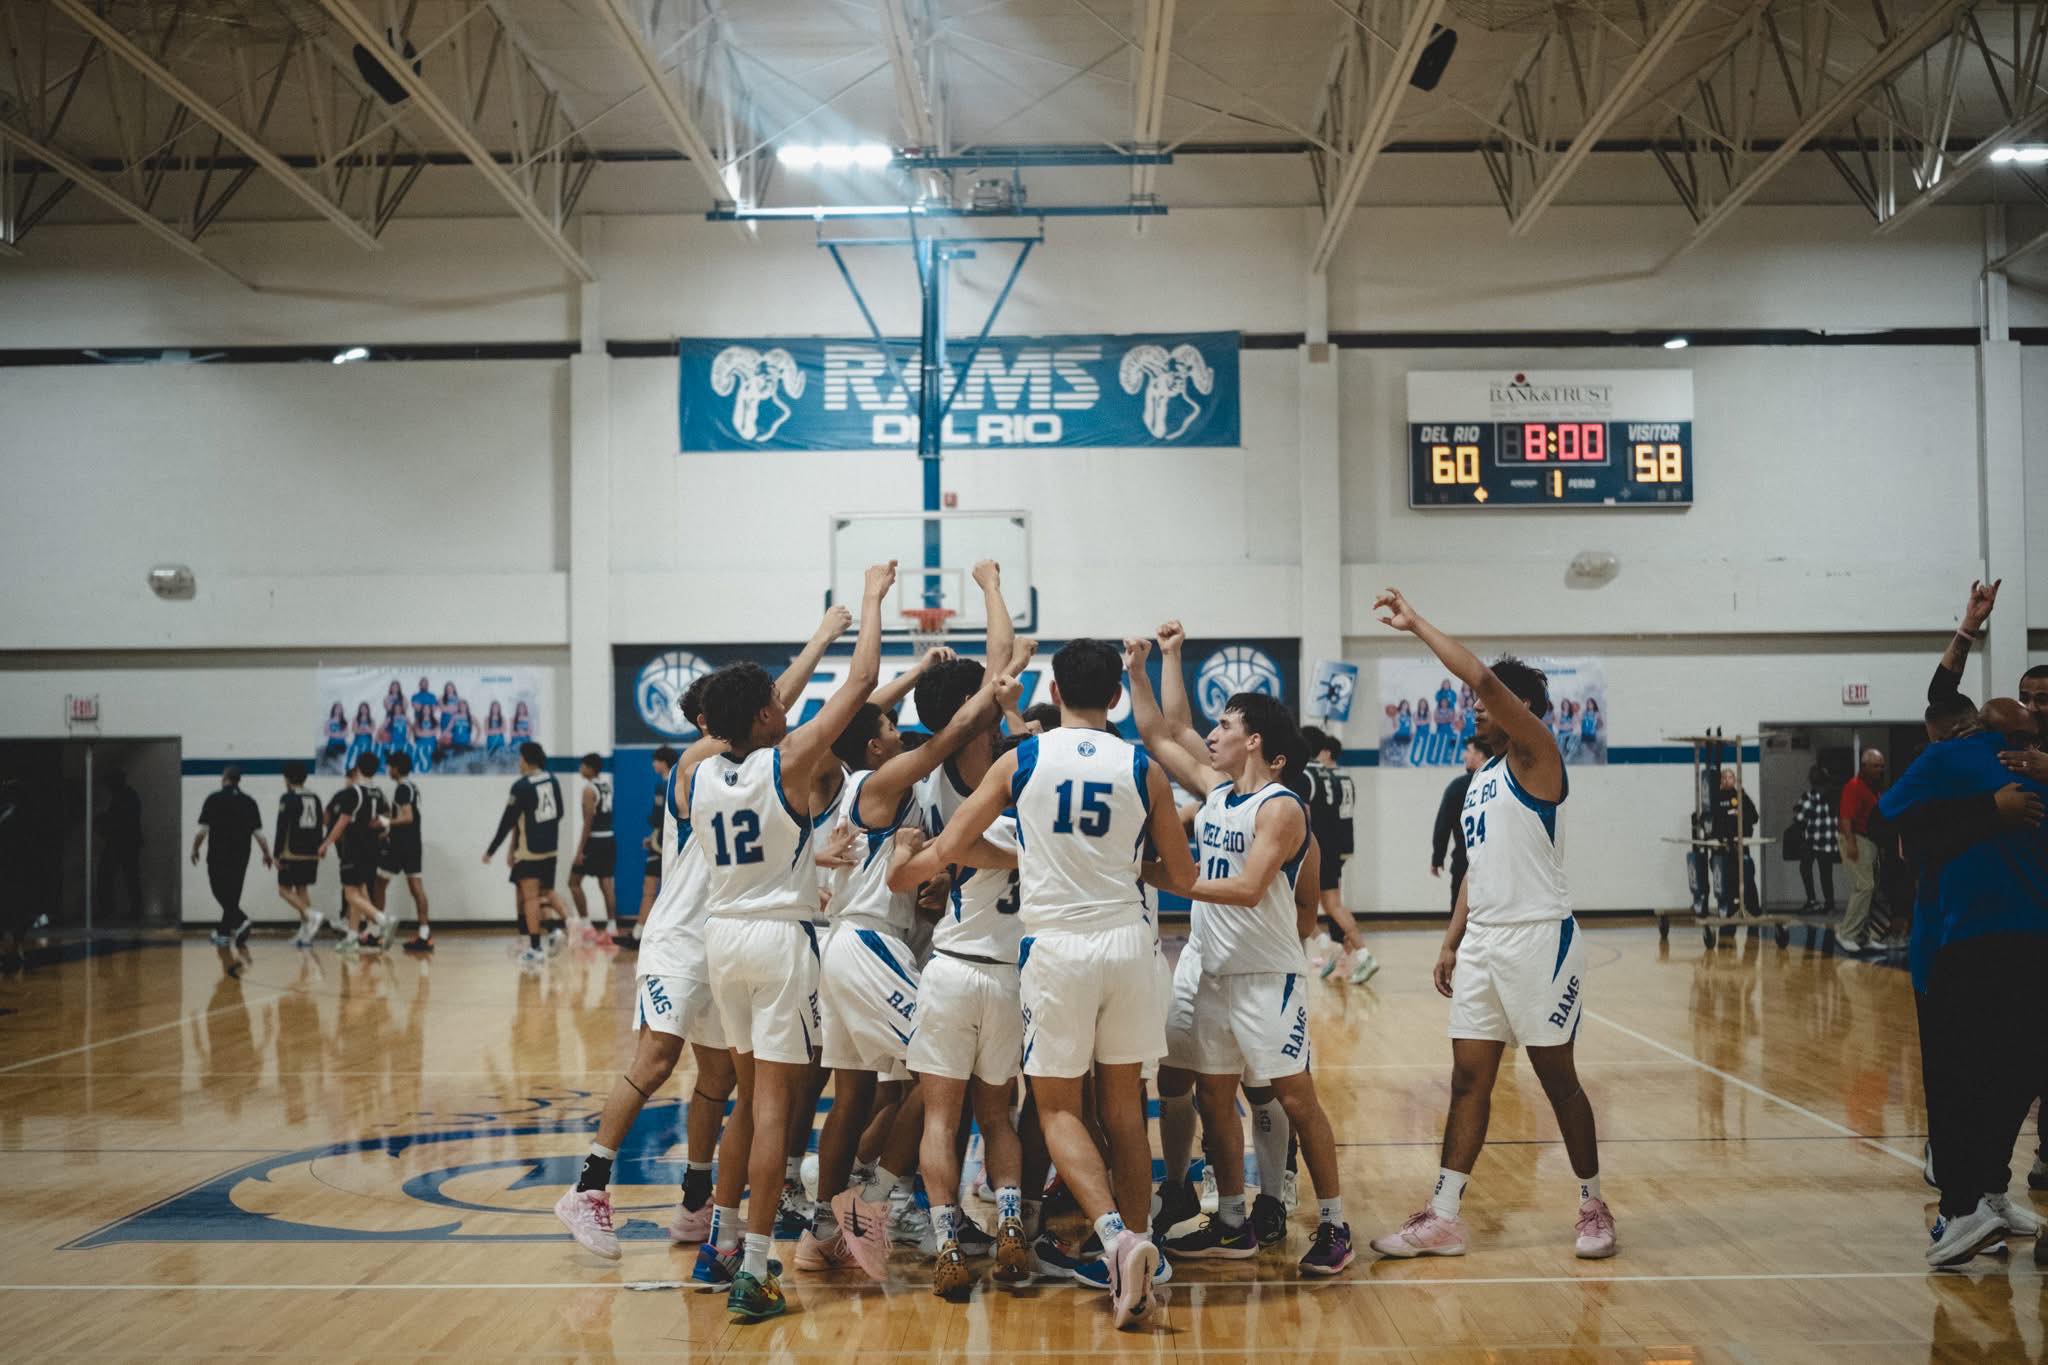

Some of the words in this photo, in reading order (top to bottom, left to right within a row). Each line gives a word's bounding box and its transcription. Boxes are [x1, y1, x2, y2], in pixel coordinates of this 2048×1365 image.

[824, 345, 1102, 410] RAMS
[977, 414, 1062, 444] RIO
[1420, 426, 1448, 443] DEL
[1454, 425, 1480, 442] RIO
[1524, 423, 1604, 461] 8:00
[1628, 424, 1680, 441] VISITOR
[1432, 446, 1480, 484] 60
[1635, 444, 1683, 483] 58
[1053, 779, 1113, 837] 15
[711, 808, 765, 867] 12
[1465, 811, 1486, 849] 24
[646, 974, 672, 1015] AMS
[886, 990, 917, 1022] RA
[1549, 975, 1580, 1029] RAMS
[1281, 1006, 1307, 1060] RAMS
